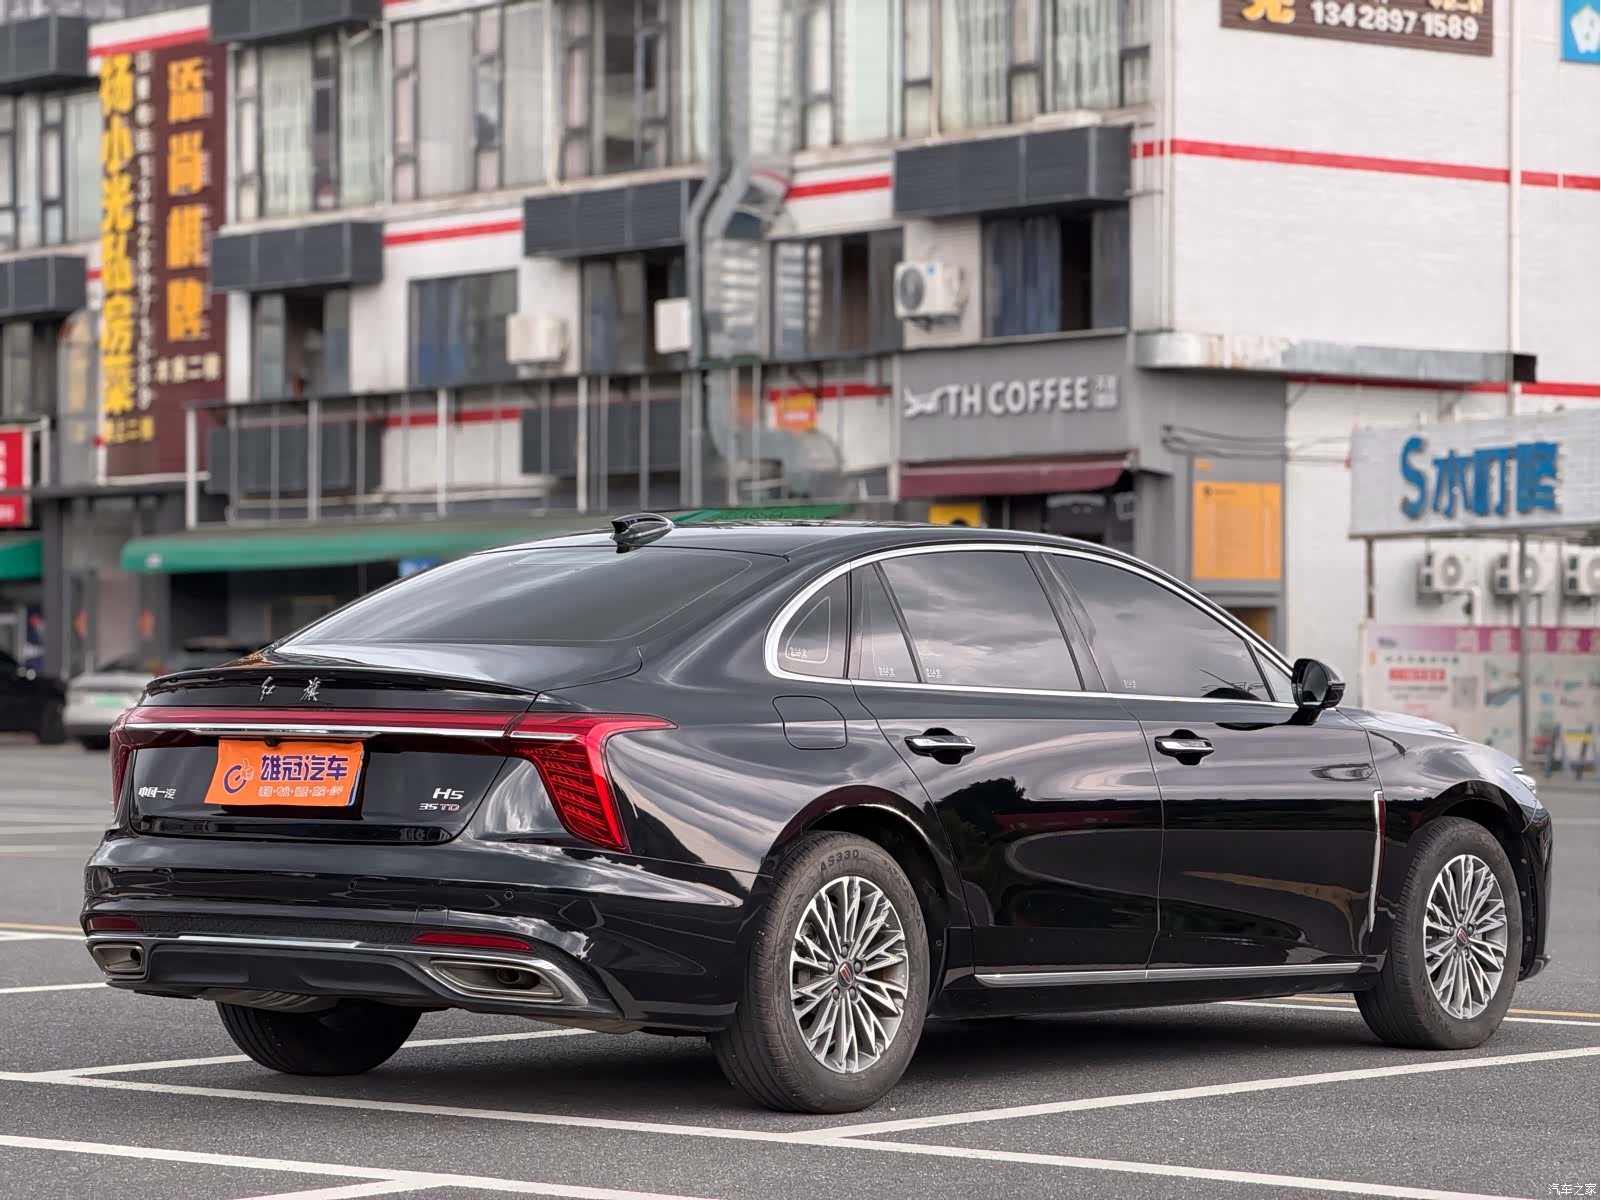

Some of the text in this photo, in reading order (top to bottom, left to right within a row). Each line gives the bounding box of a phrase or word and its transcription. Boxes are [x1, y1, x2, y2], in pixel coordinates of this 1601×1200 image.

[987, 376, 1089, 415] COFFEE
[260, 755, 349, 781] 雄冠汽车
[432, 787, 465, 800] H5
[820, 849, 860, 872] AS330
